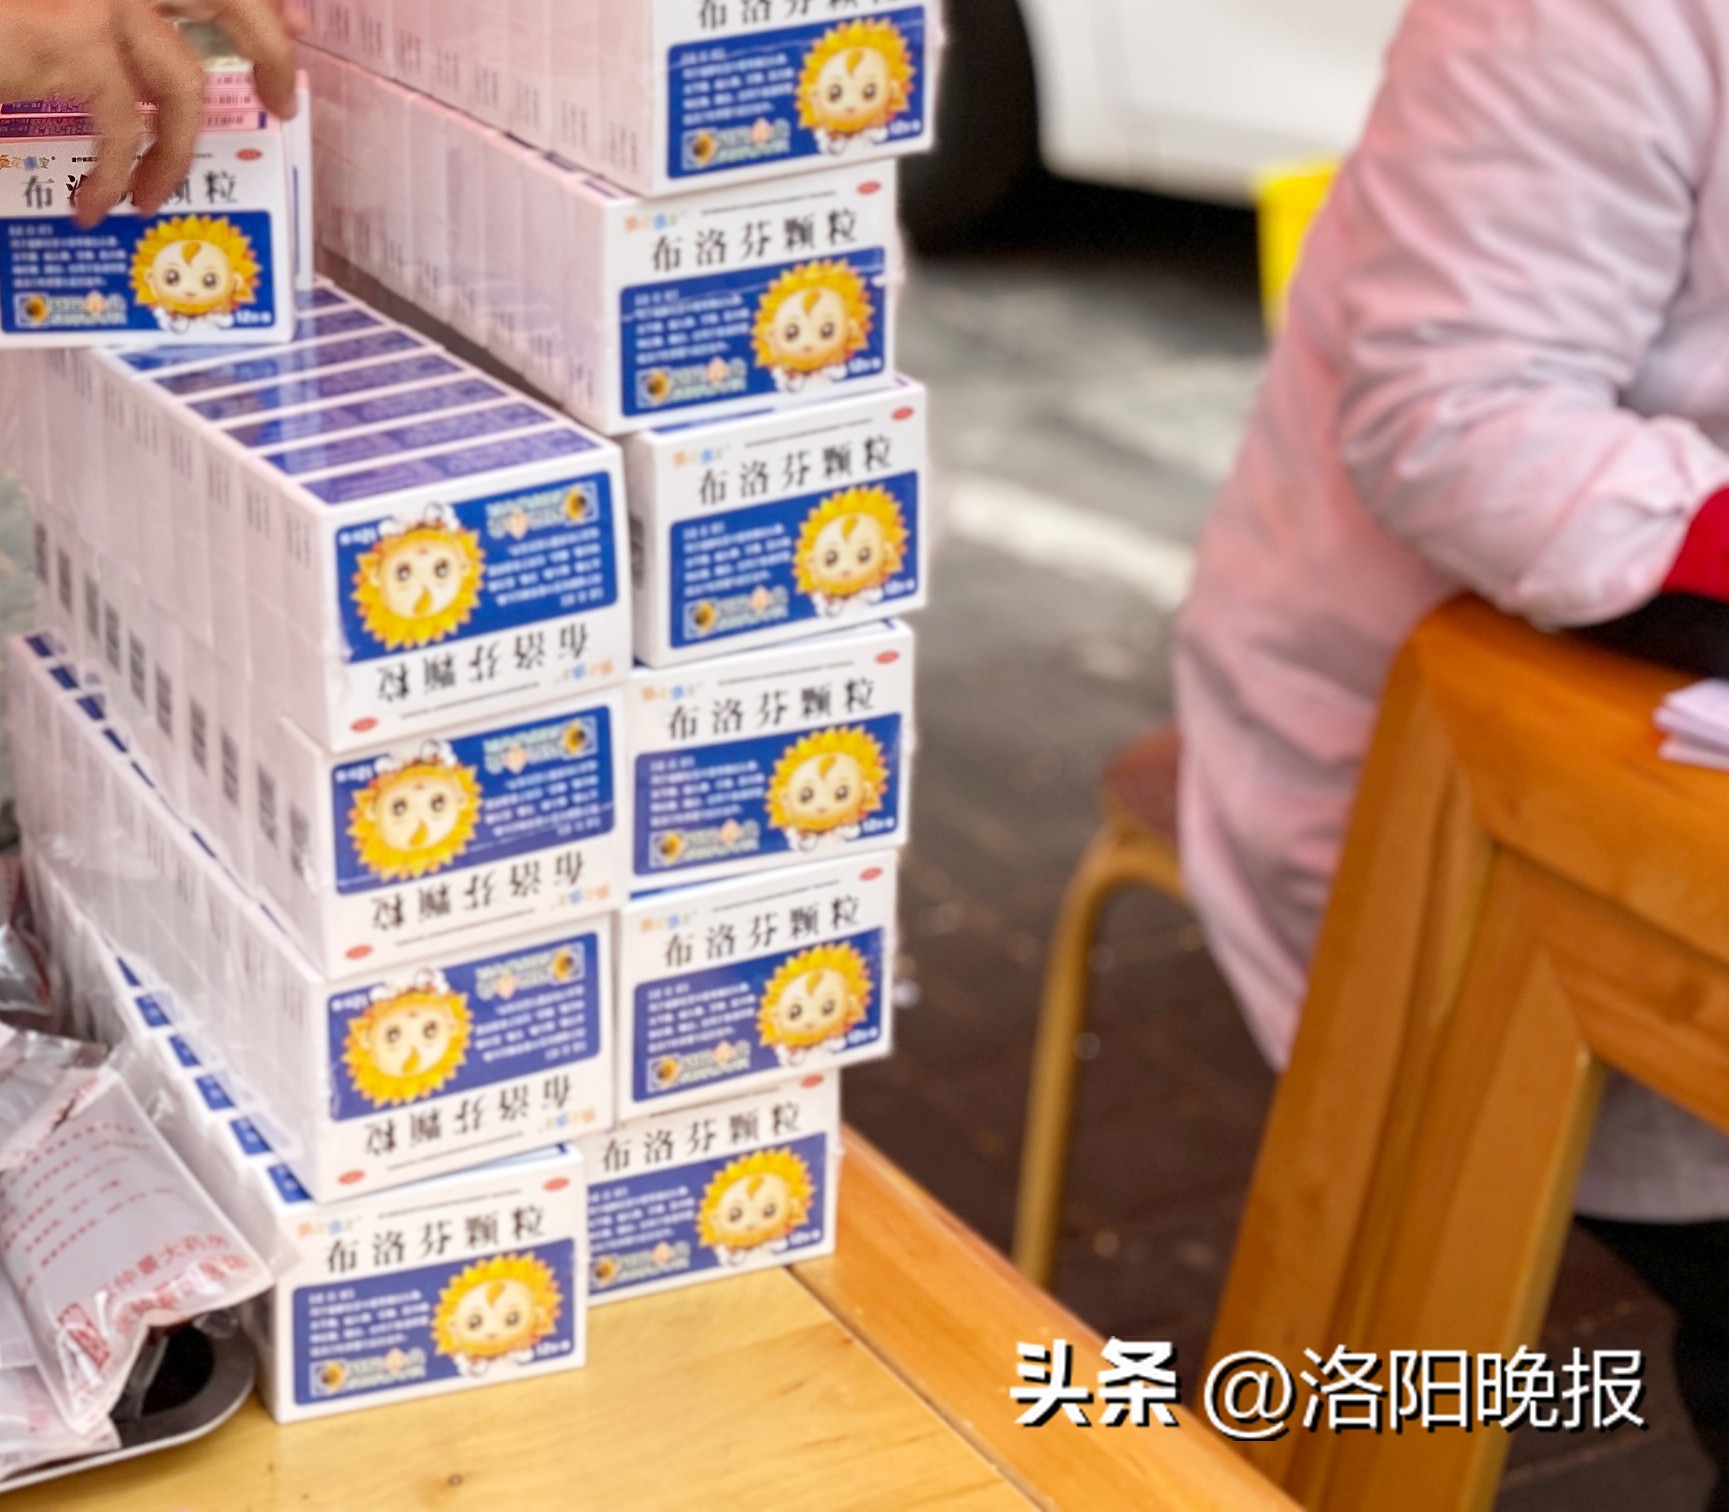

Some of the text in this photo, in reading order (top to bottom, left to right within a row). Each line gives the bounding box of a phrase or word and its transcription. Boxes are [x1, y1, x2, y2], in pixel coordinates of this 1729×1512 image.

[650, 206, 858, 274] 布洛芬颗粒
[698, 432, 894, 506] 布洛芬颗粒
[375, 622, 591, 703] 布洛芬颗粒
[666, 675, 876, 741] 布洛芬颗粒
[369, 852, 587, 934] 布洛芬颗粒
[663, 898, 862, 967] 布洛芬颗粒
[363, 1073, 573, 1157] 布洛芬颗粒
[601, 1100, 803, 1172] 布洛芬颗粒
[325, 1204, 547, 1274] 布洛芬颗粒
